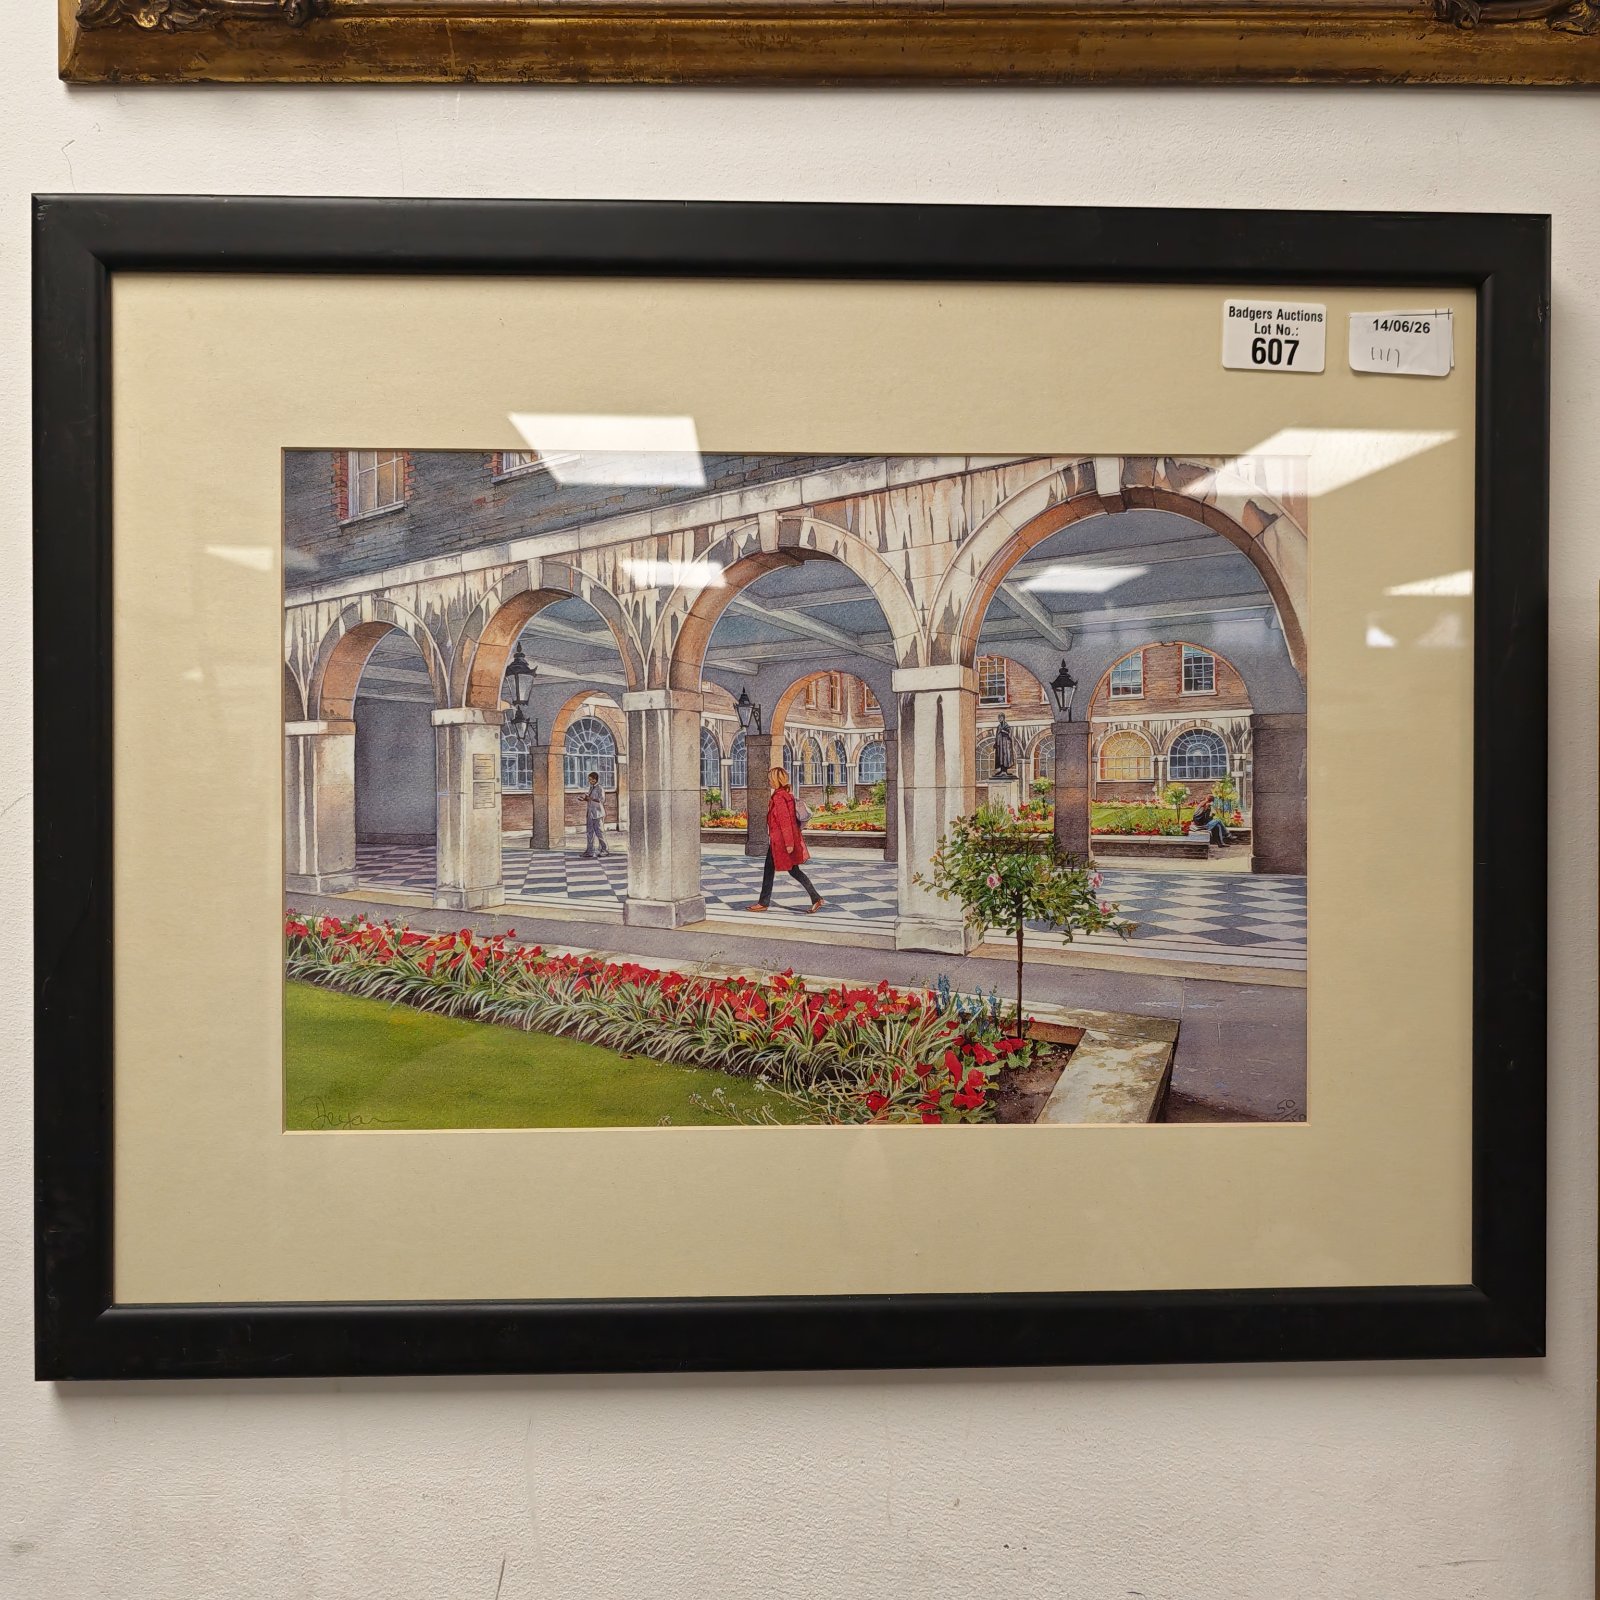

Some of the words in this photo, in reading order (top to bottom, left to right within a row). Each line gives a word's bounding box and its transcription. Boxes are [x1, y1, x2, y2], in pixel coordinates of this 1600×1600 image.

[1229, 306, 1273, 321] Badgers
[1276, 308, 1323, 322] Auctions
[1254, 322, 1271, 335] Lot
[1276, 324, 1299, 336] No.:
[1373, 319, 1431, 334] 14/06/26
[1251, 337, 1300, 366] 607
